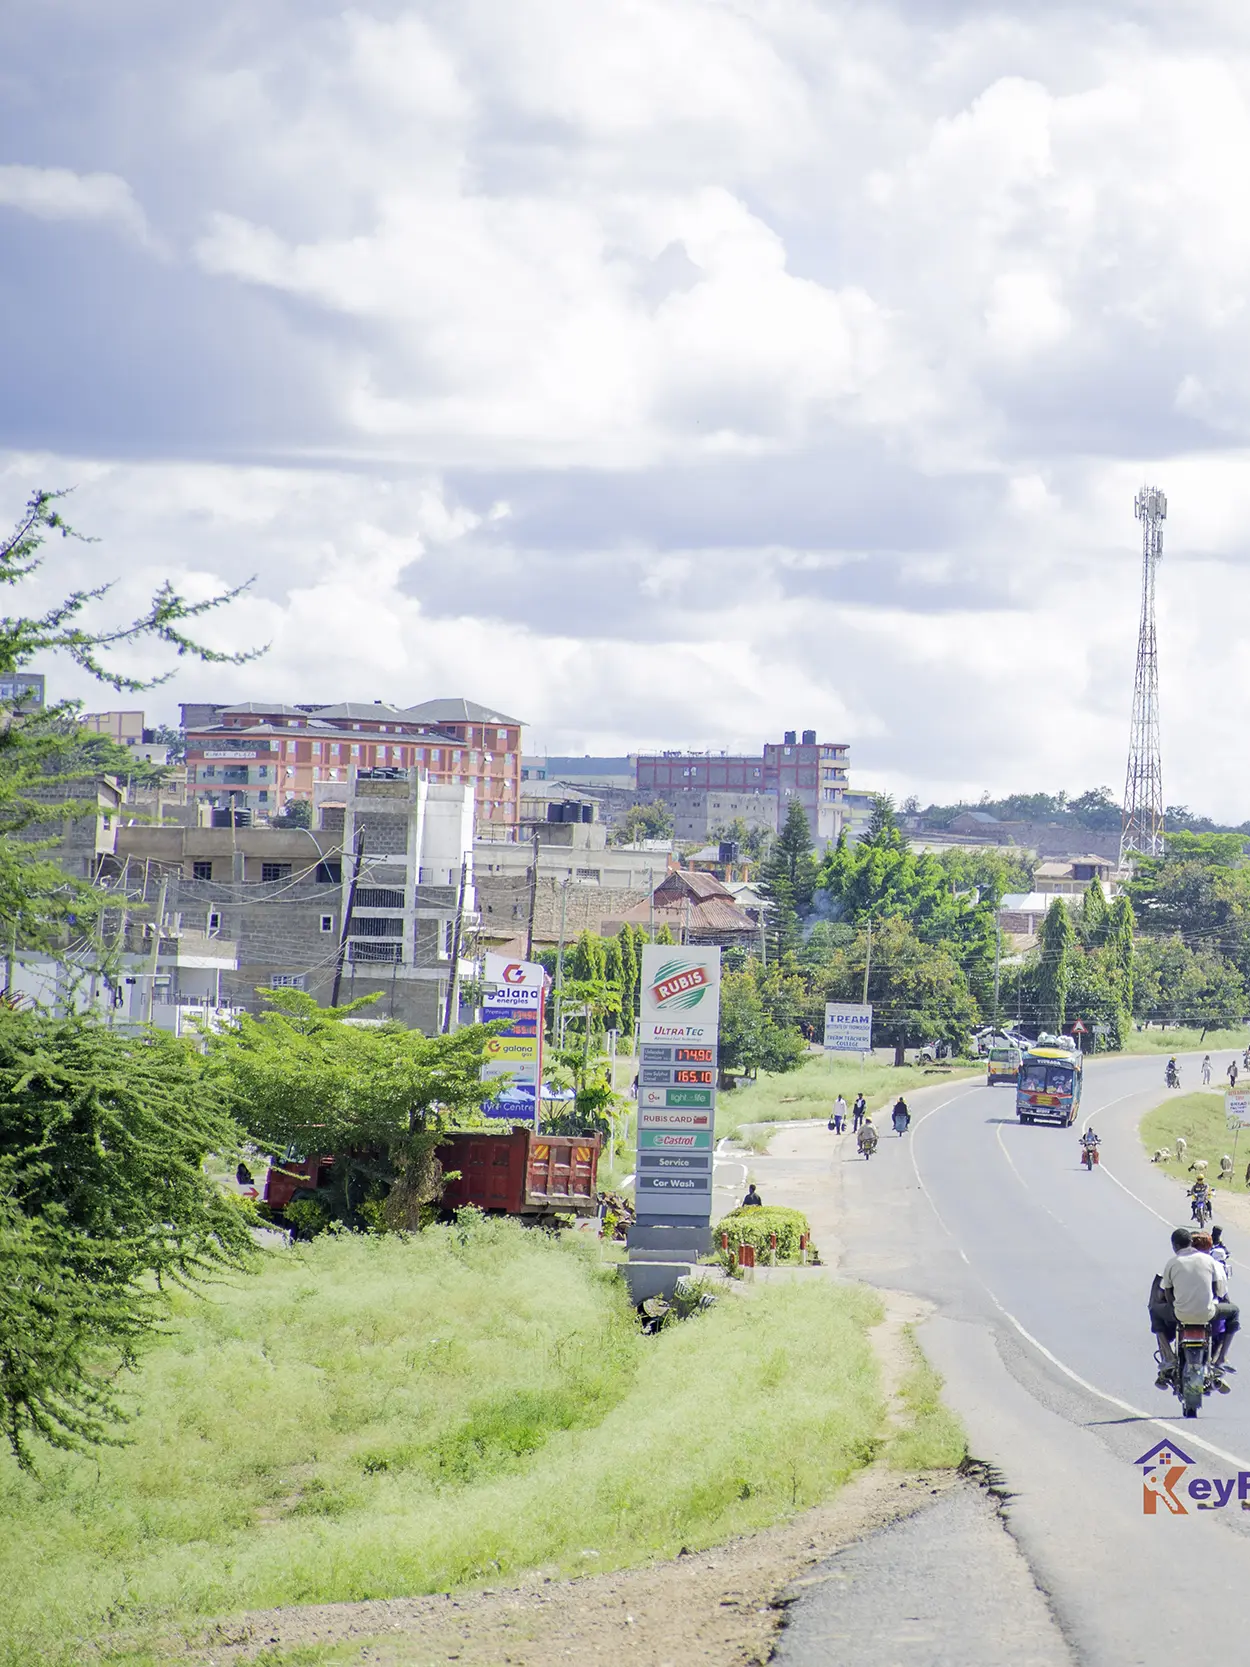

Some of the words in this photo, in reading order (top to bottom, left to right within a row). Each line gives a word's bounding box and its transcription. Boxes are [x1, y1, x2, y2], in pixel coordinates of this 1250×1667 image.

[829, 1015, 869, 1023] TREAM
[678, 1070, 712, 1083] 165.10
[670, 1094, 687, 1103] light
[503, 1103, 534, 1112] Centre
[669, 1115, 692, 1123] CARD
[663, 1135, 694, 1145] Castrol
[659, 1158, 690, 1166] Service
[653, 1179, 668, 1187] Car
[670, 1179, 695, 1188] Wash
